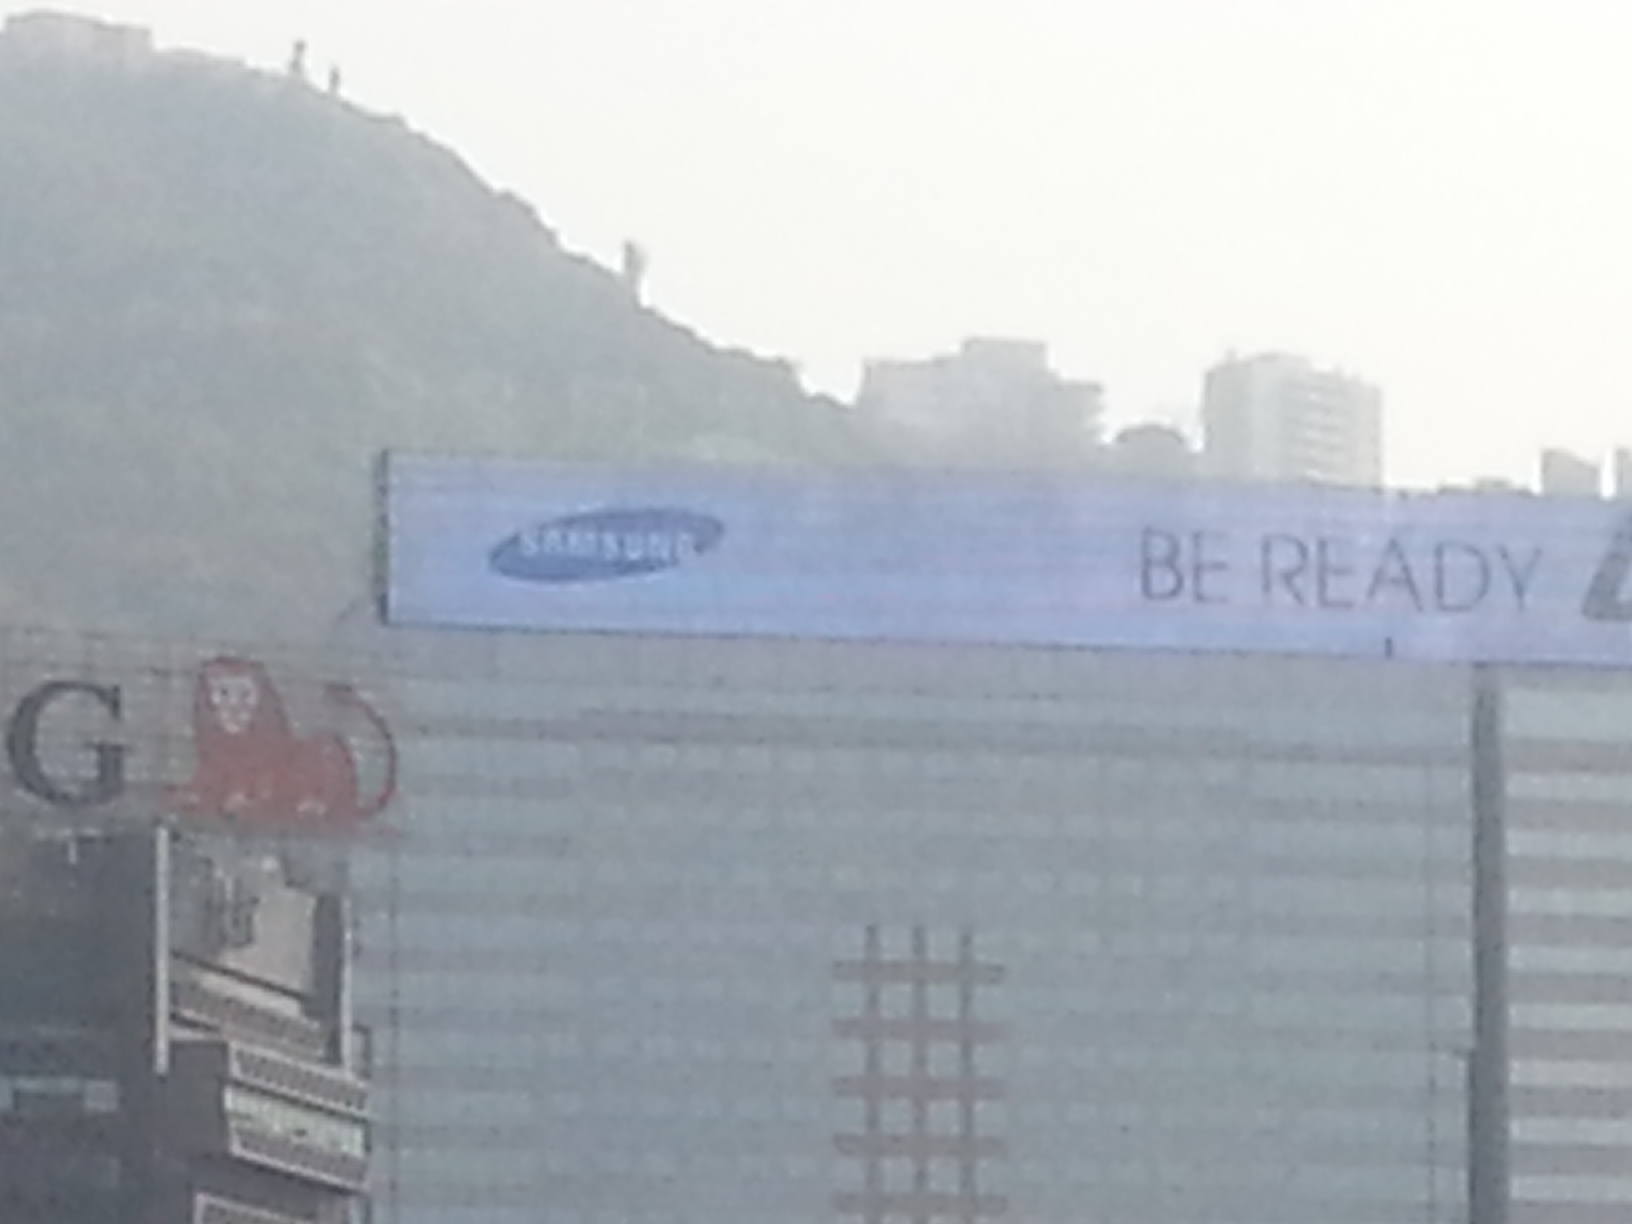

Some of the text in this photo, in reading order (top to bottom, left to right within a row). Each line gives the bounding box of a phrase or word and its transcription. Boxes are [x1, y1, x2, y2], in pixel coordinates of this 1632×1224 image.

[1140, 526, 1230, 603] BE
[1260, 533, 1542, 613] READY
[7, 680, 130, 806] G
